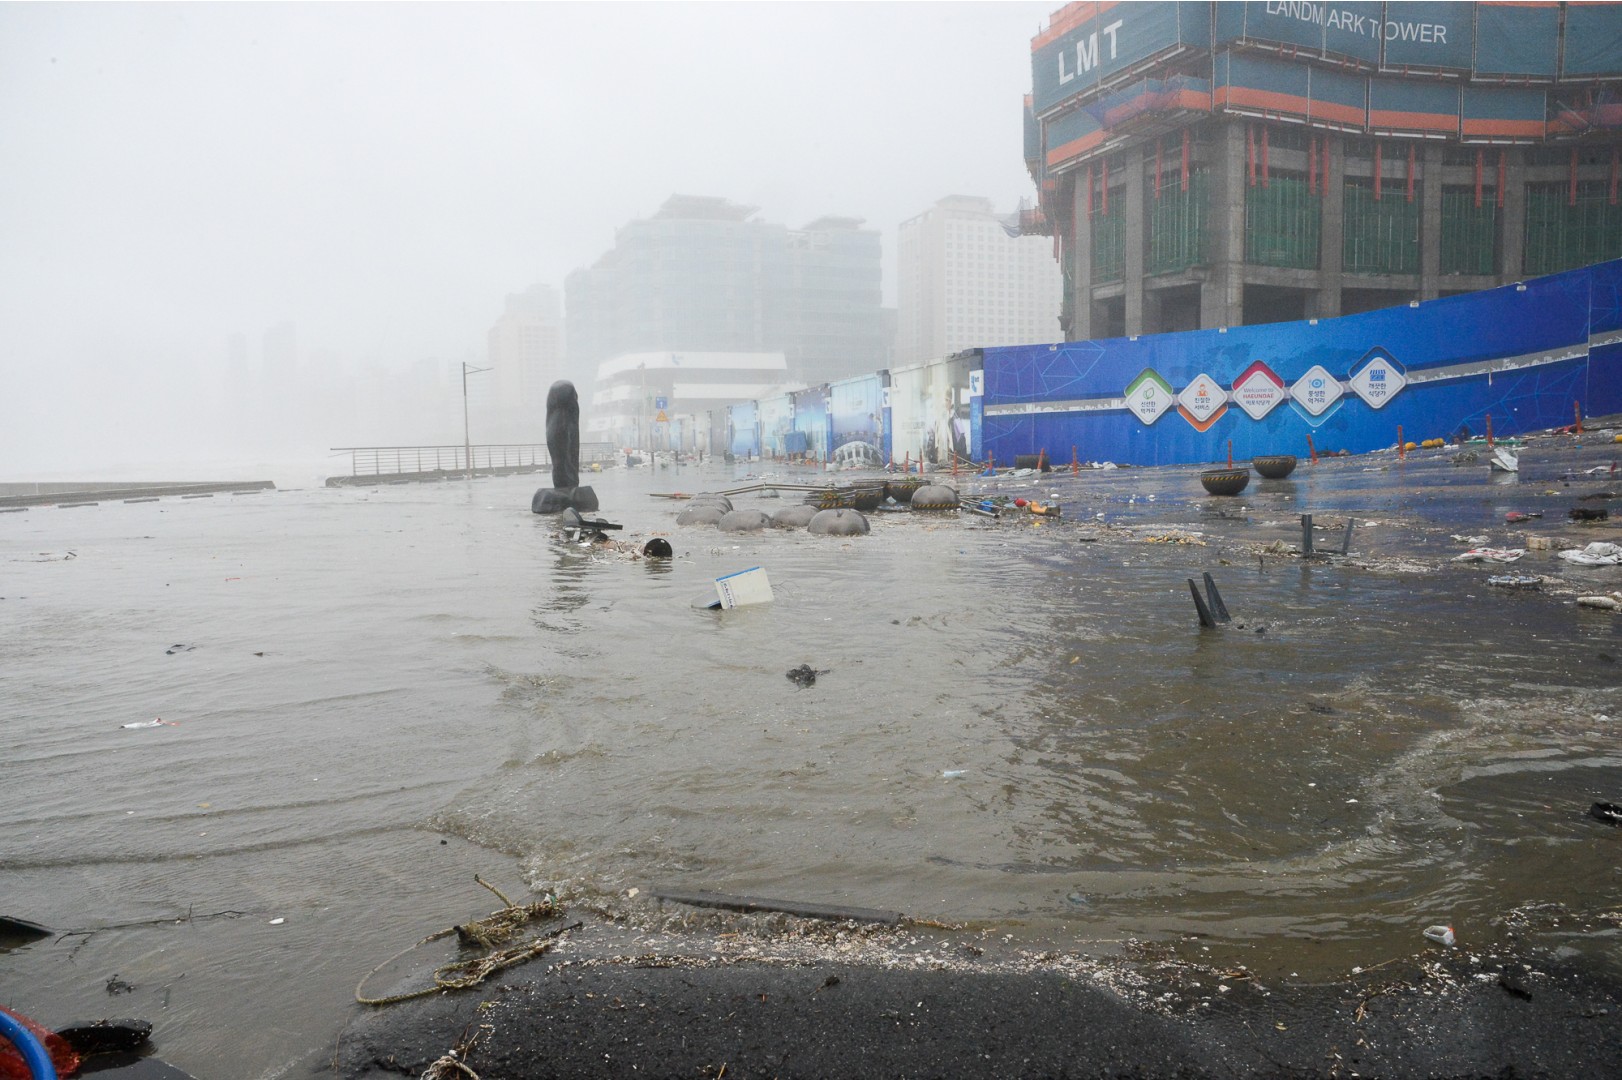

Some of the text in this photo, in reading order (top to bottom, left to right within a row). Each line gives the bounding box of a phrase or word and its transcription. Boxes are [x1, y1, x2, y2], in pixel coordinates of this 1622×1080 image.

[1266, 1, 1447, 44] LANDMARK TOWER
[1058, 19, 1123, 86] LMT
